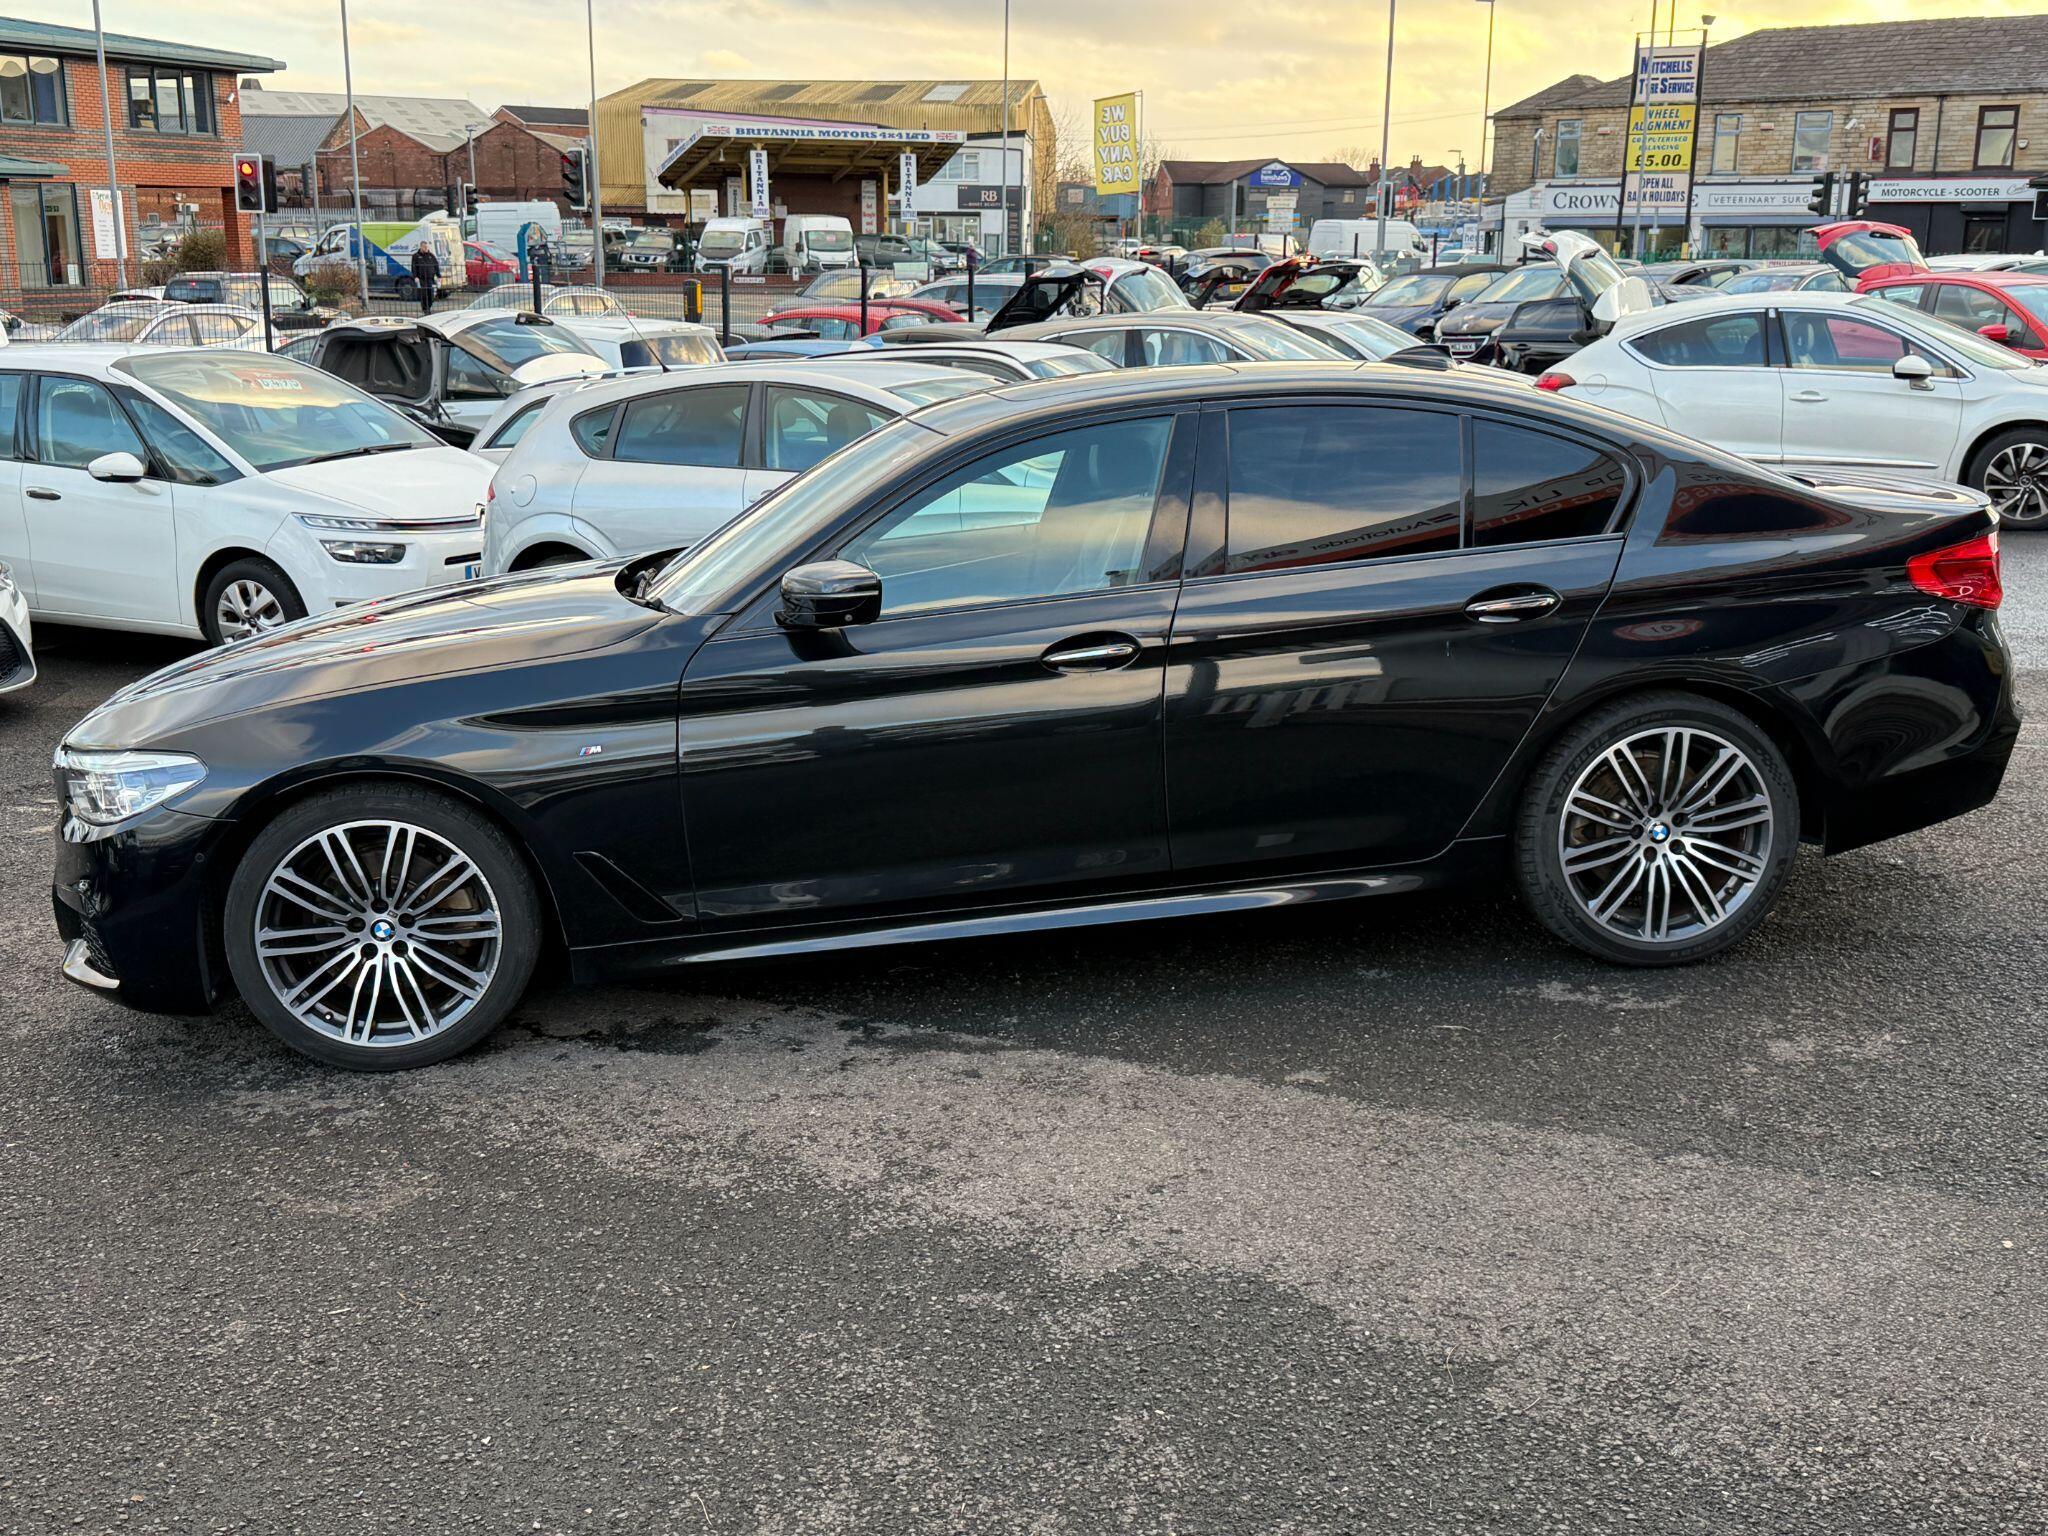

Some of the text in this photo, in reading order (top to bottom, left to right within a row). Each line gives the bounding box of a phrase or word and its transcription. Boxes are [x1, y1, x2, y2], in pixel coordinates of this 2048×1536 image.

[1639, 77, 1695, 94] TRE SERVICE
[1632, 120, 1691, 131] ALGNMENT
[735, 127, 816, 137] BRITANNIA
[818, 129, 878, 139] MOTORS
[905, 131, 931, 141] LTD
[1632, 135, 1688, 143] COPUTERISED
[755, 152, 765, 207] BRITANNIA
[1661, 177, 1674, 189] ALL
[981, 190, 998, 202] RB
[1627, 191, 1648, 202] BAK
[1649, 190, 1686, 202] HOLIDAYS
[1881, 188, 1946, 197] MOTORCYCLE
[1954, 187, 2000, 197] SCOOTER
[1553, 192, 1620, 209] CROWN
[1713, 195, 1838, 204] VETERINARY SURGS
